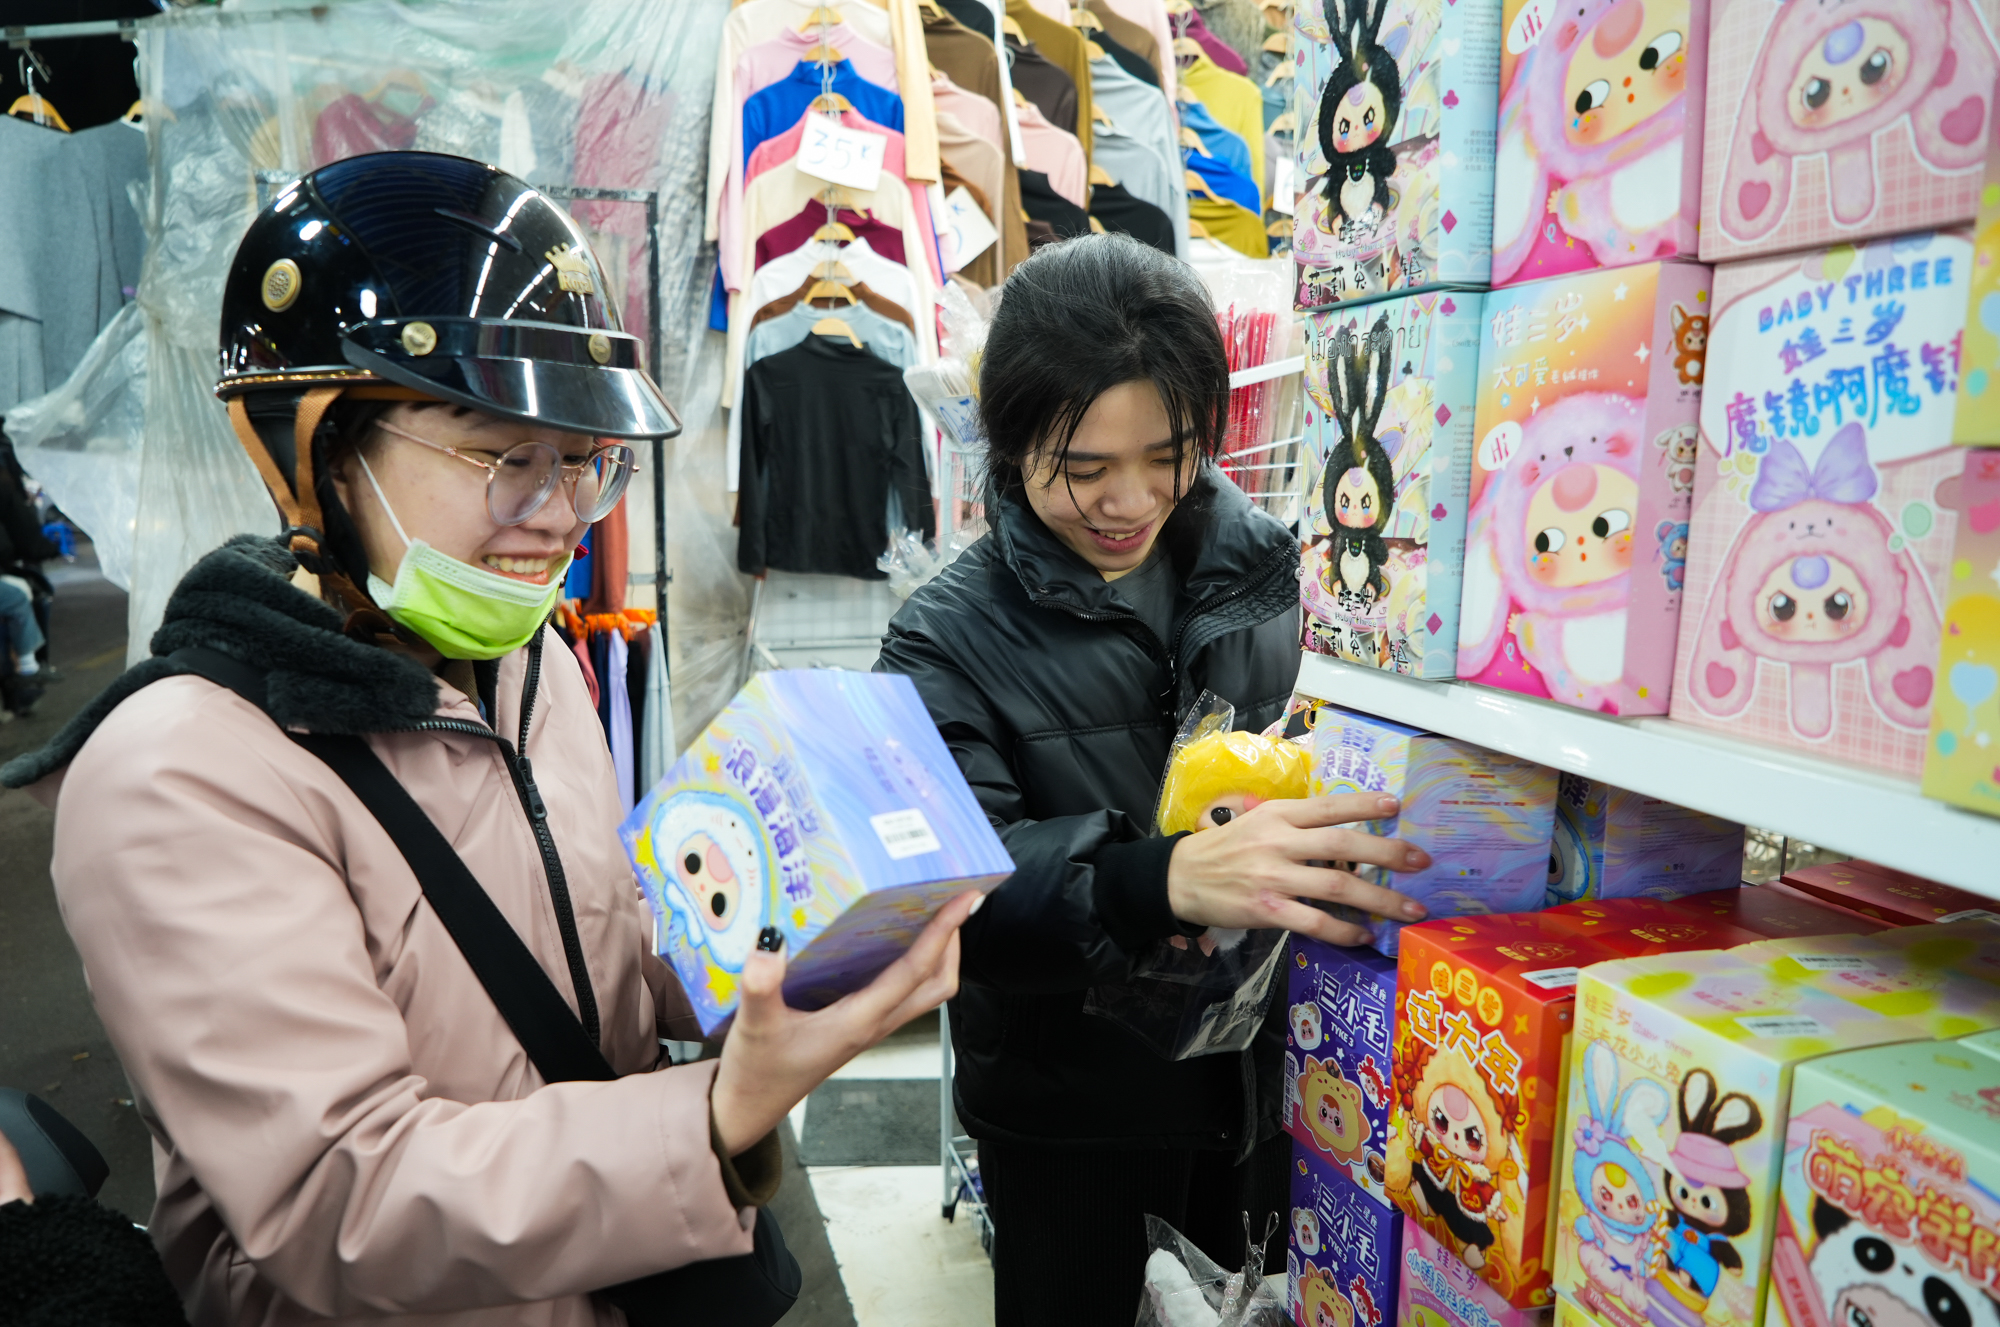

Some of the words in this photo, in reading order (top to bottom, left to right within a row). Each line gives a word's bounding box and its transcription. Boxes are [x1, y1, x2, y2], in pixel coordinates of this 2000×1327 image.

[1519, 5, 1543, 38] Hi
[1490, 291, 1584, 349] 娃三岁
[1758, 282, 1836, 334] BABY
[1843, 256, 1954, 304] THREE
[1311, 308, 1421, 362] เมืองกระต่าย
[1779, 299, 1906, 375] 娃三岁
[1489, 432, 1510, 464] Hi
[1334, 612, 1353, 626] Baby
[1355, 616, 1378, 628] three
[725, 738, 813, 902] 浪漫海洋
[1353, 971, 1387, 1004] 十二星座
[1432, 965, 1501, 1023] 娃三岁
[1584, 993, 1633, 1027] 娃三岁
[1319, 974, 1387, 1053] 三小毛
[1330, 1021, 1349, 1044] TYKE
[1348, 1038, 1355, 1048] 3
[1407, 991, 1520, 1095] 过大年
[1317, 1186, 1377, 1278] 三小毛
[1349, 1191, 1379, 1230] 十二星座
[1327, 1233, 1344, 1258] TYKE
[1342, 1253, 1348, 1264] 3
[1436, 1245, 1479, 1291] 娃三岁
